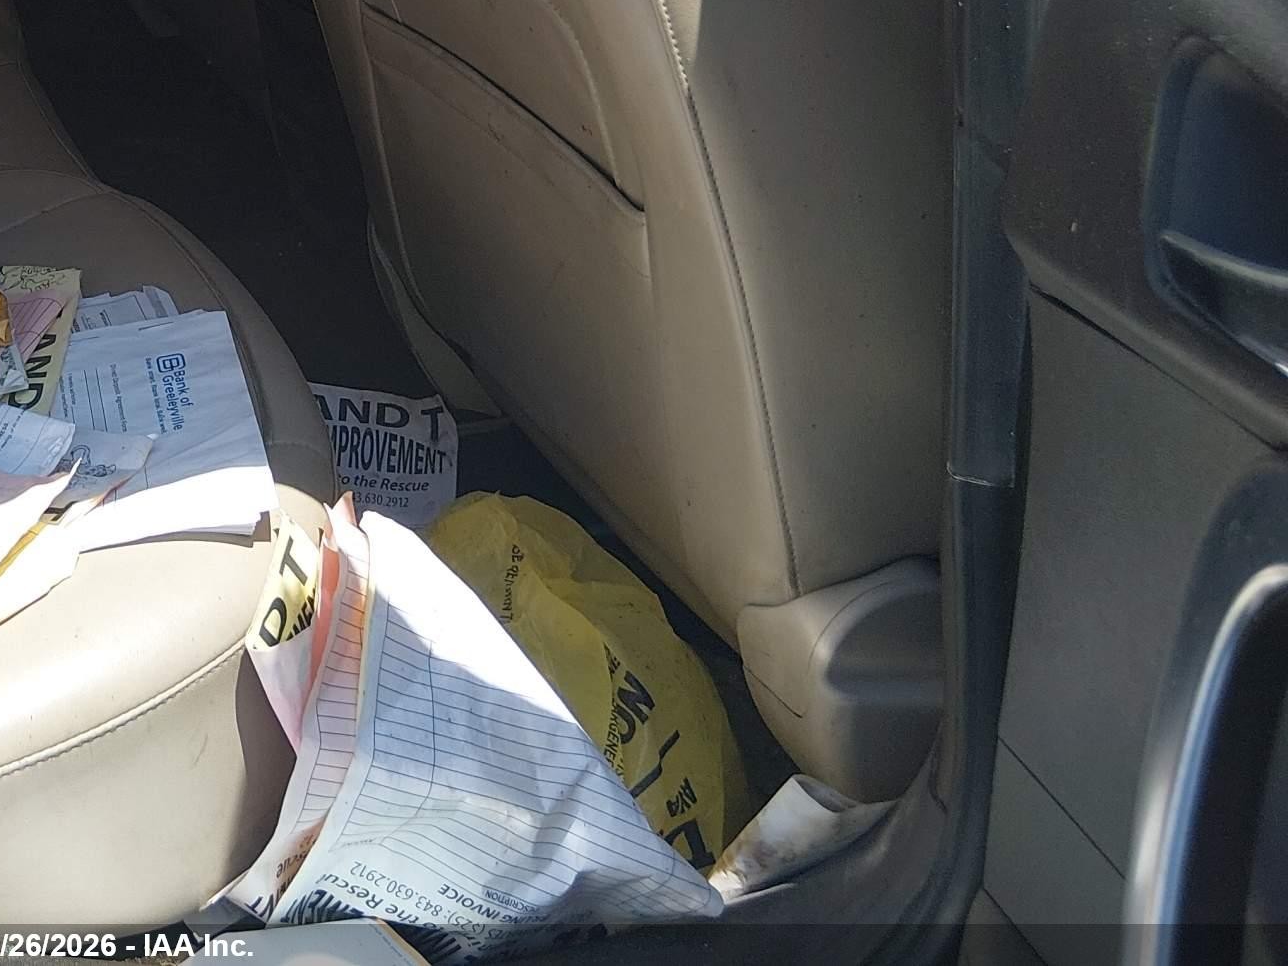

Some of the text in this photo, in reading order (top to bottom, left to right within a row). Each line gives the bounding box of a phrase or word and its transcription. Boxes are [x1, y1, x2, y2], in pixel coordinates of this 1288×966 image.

[162, 375, 184, 431] Greeleyville
[173, 369, 194, 408] Bank of
[421, 407, 444, 444] T
[354, 475, 377, 488] the
[380, 478, 430, 492] Rescue
[437, 884, 501, 919] INVOICE
